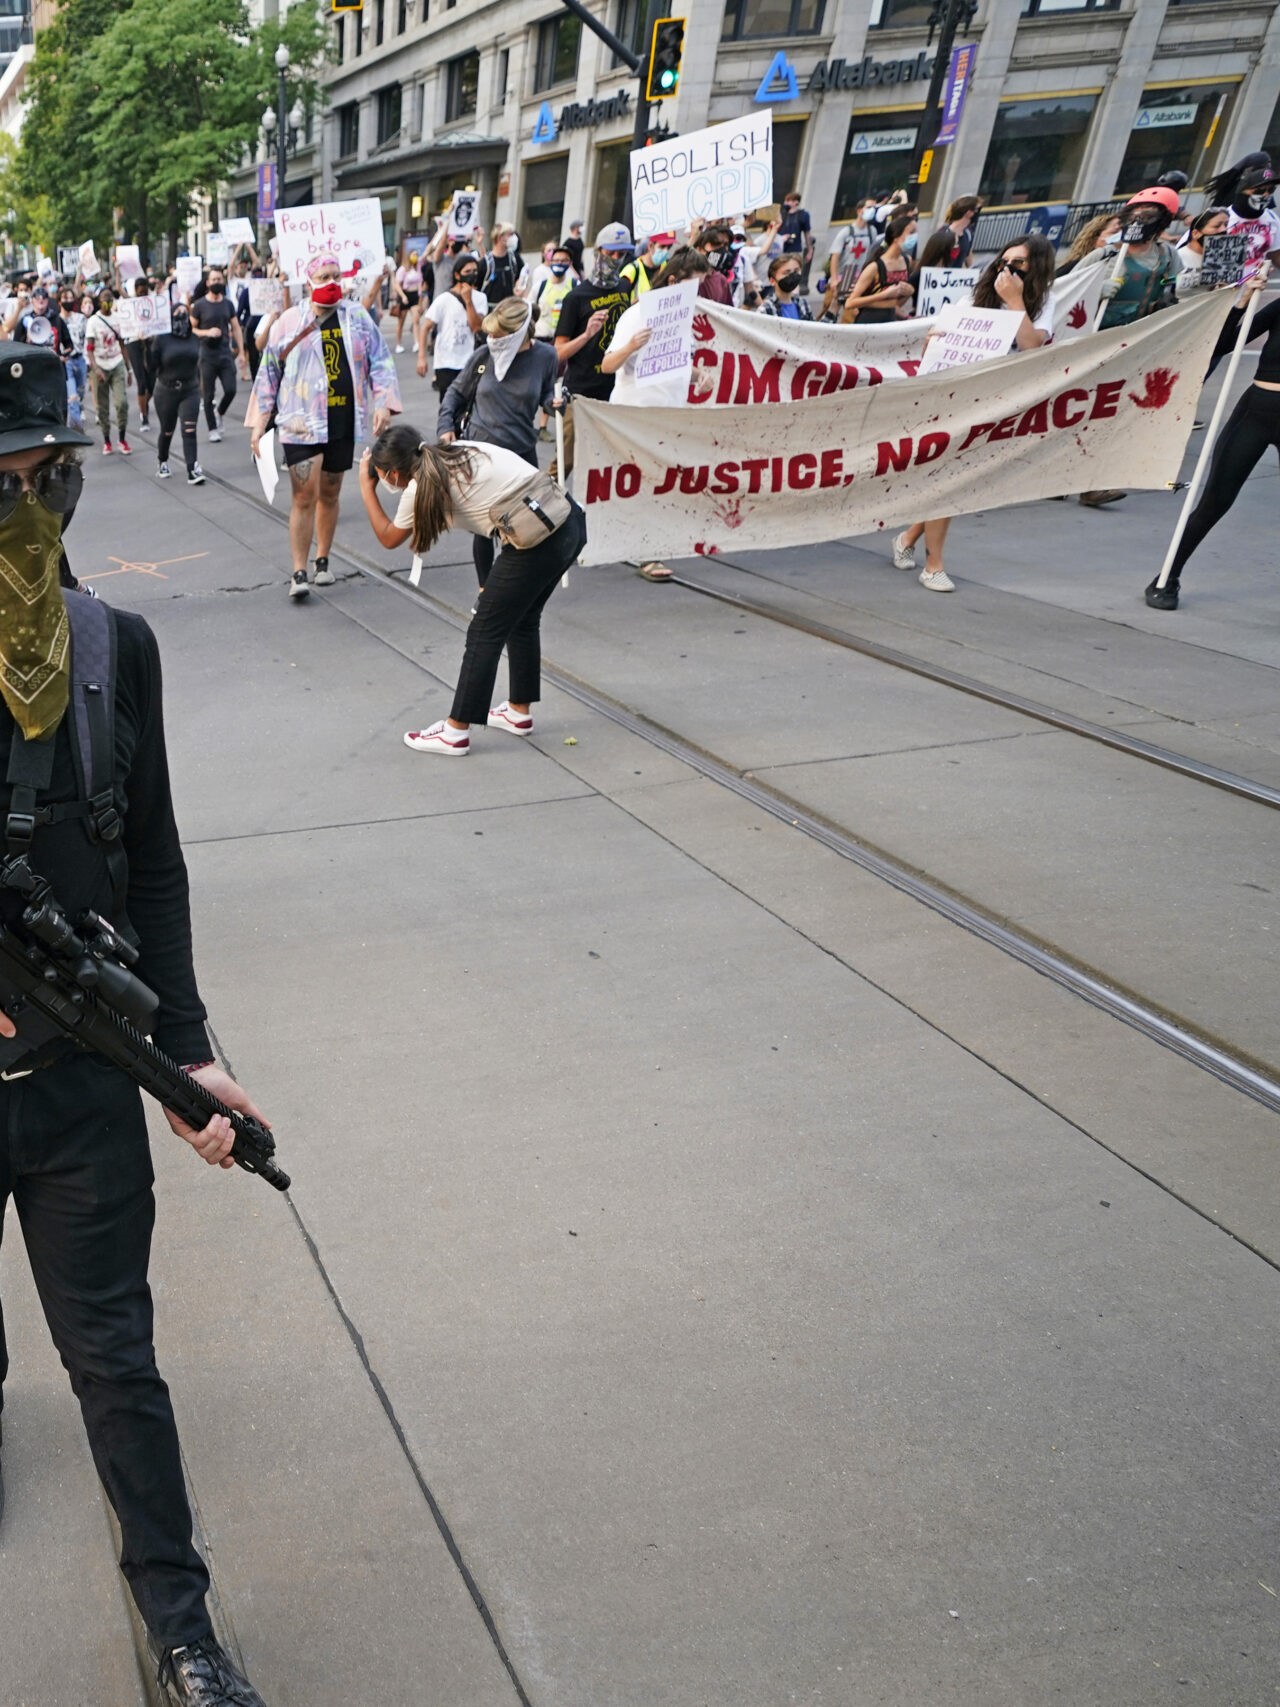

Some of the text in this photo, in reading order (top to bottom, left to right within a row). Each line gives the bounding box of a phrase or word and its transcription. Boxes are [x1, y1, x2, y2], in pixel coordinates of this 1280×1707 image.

[807, 52, 937, 92] Altabank
[558, 89, 630, 130] Altabank
[635, 127, 770, 190] ABOLISH
[634, 161, 771, 236] SLCPD
[282, 209, 336, 236] People
[308, 238, 361, 254] before
[658, 294, 682, 311] FROM
[646, 307, 690, 329] PORTLAND
[957, 318, 994, 333] FROM
[652, 325, 681, 342] TO SLC
[937, 331, 1003, 351] PORTLAND
[636, 352, 689, 379] THE POLICE
[943, 349, 956, 361] TO
[586, 379, 1126, 504] NO JUSTICE, NO PEACE
